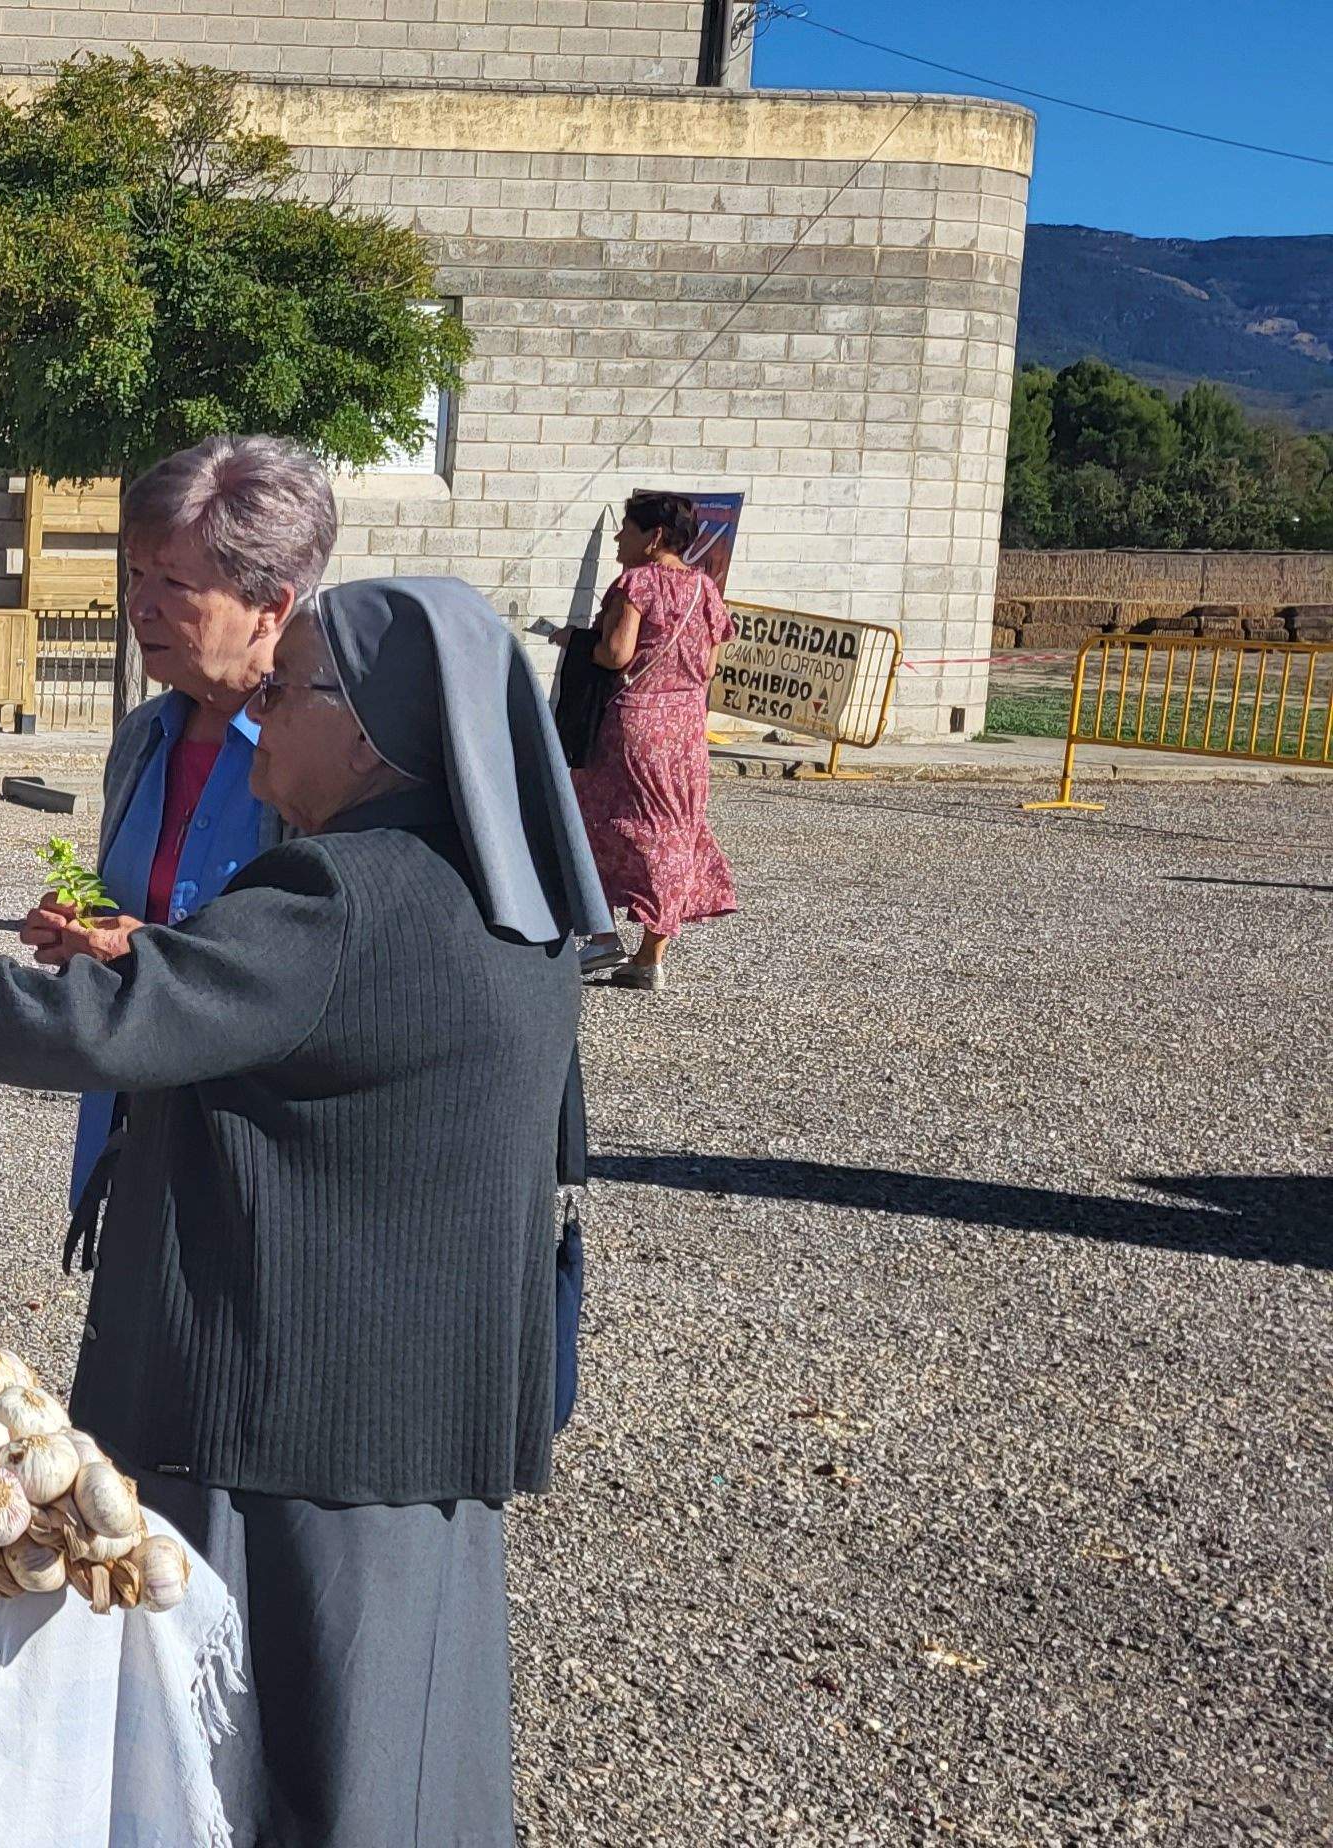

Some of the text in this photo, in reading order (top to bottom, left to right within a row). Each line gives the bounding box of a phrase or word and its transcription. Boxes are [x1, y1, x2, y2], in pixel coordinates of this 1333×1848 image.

[711, 662, 813, 701] PROHIBIDO
[722, 688, 793, 720] EL PASO
